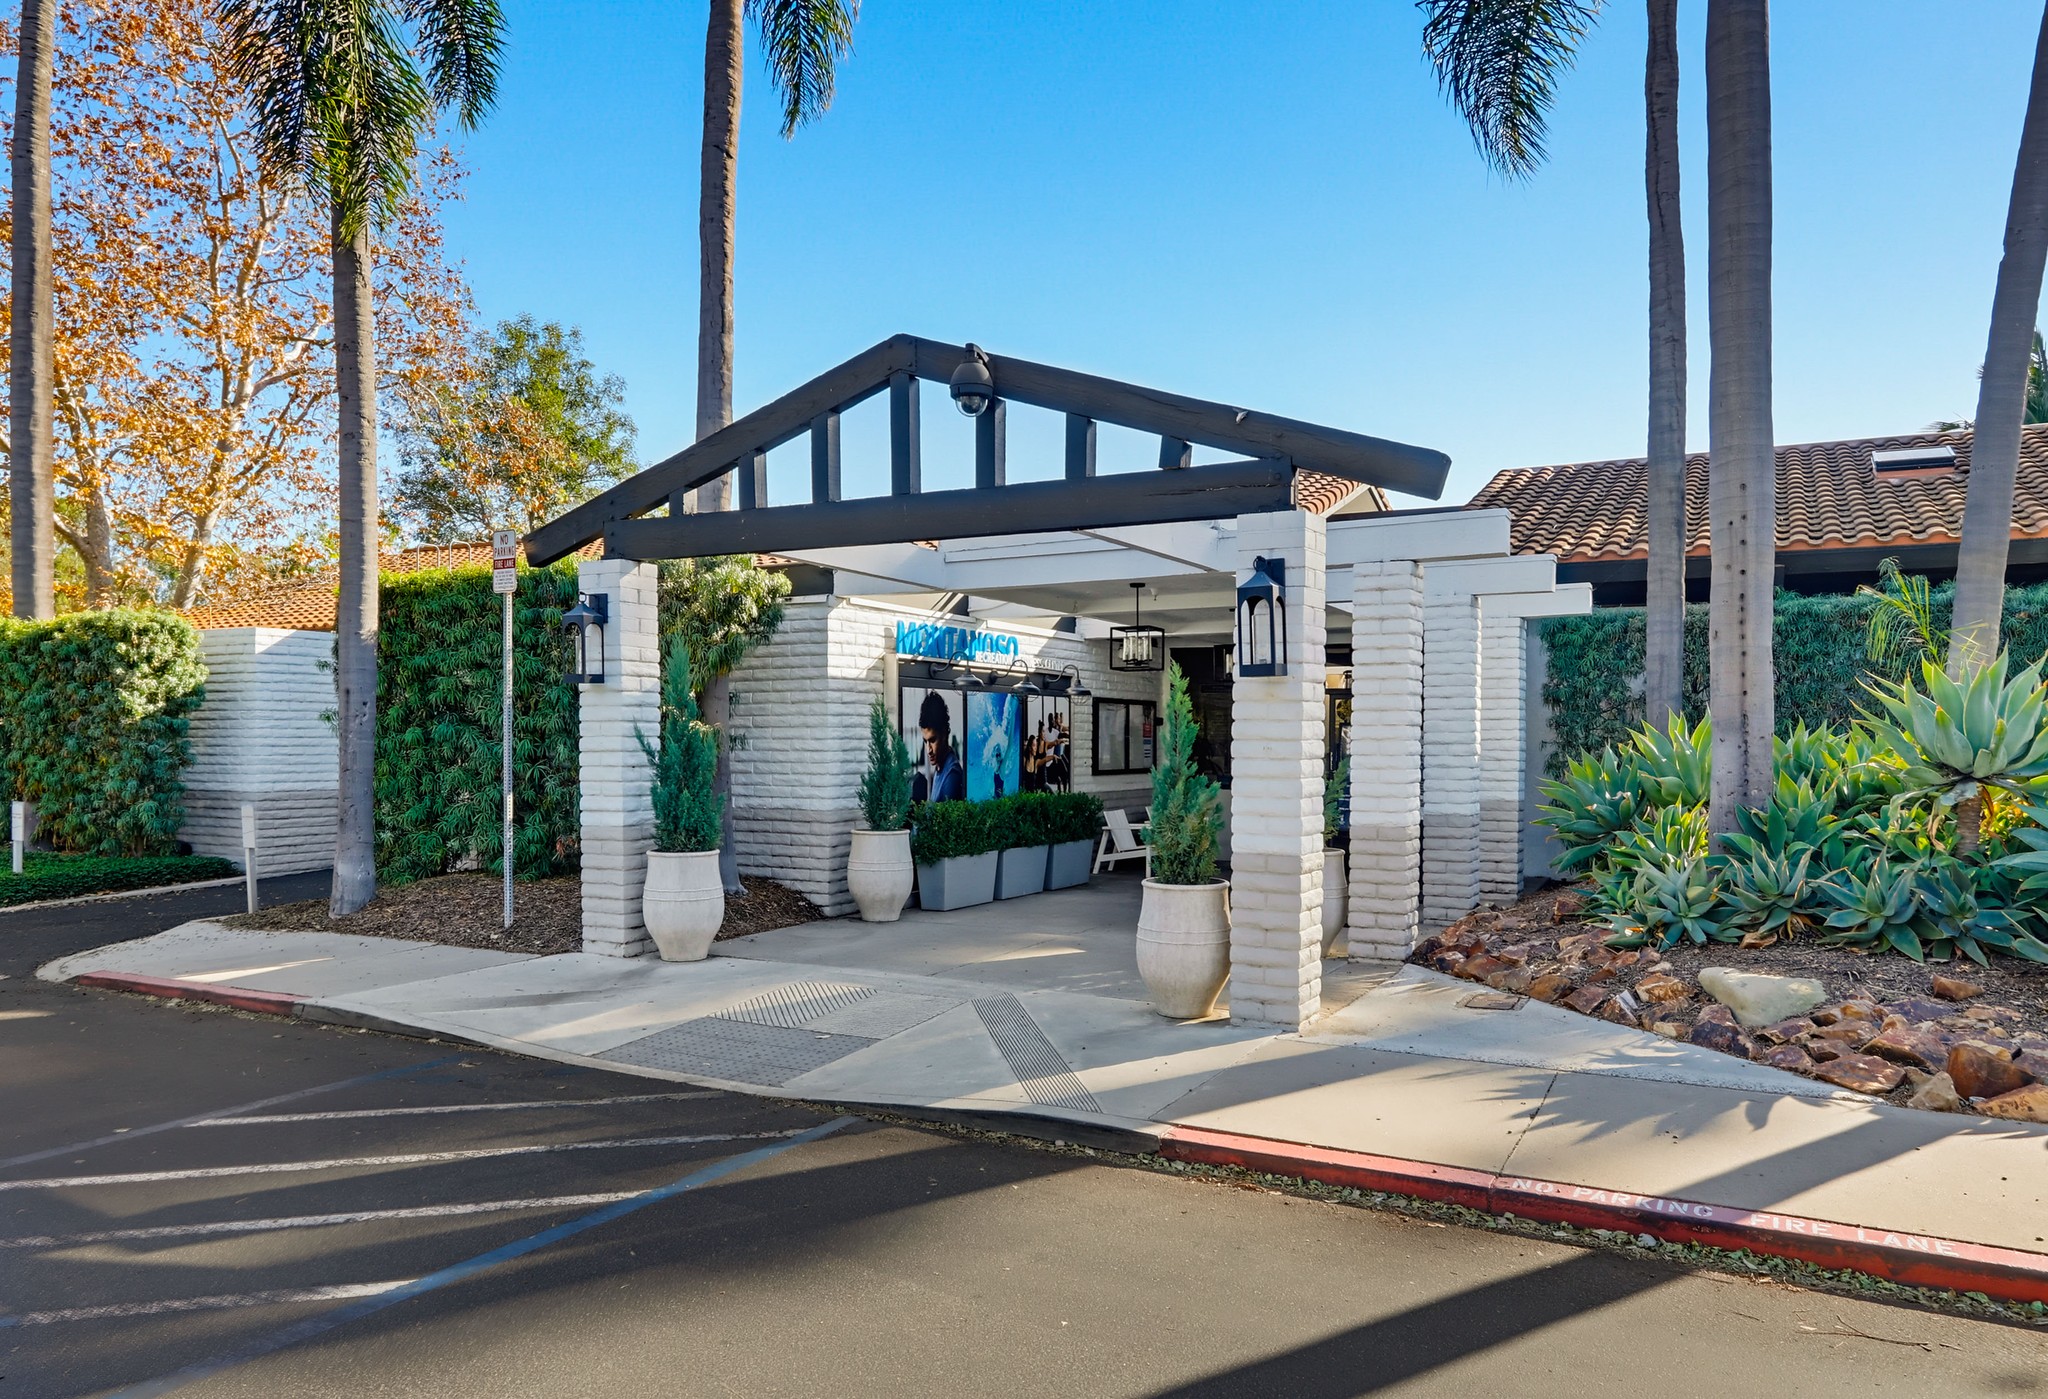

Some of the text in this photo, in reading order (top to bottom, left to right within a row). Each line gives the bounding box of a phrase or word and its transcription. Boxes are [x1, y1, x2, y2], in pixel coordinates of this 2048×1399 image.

[500, 534, 508, 545] NO
[495, 545, 514, 556] PARKING
[896, 620, 1018, 661] MONTANOSO
[975, 651, 1013, 665] RECREATION
[1512, 1178, 1960, 1257] NO PARKING FIRE LANE
